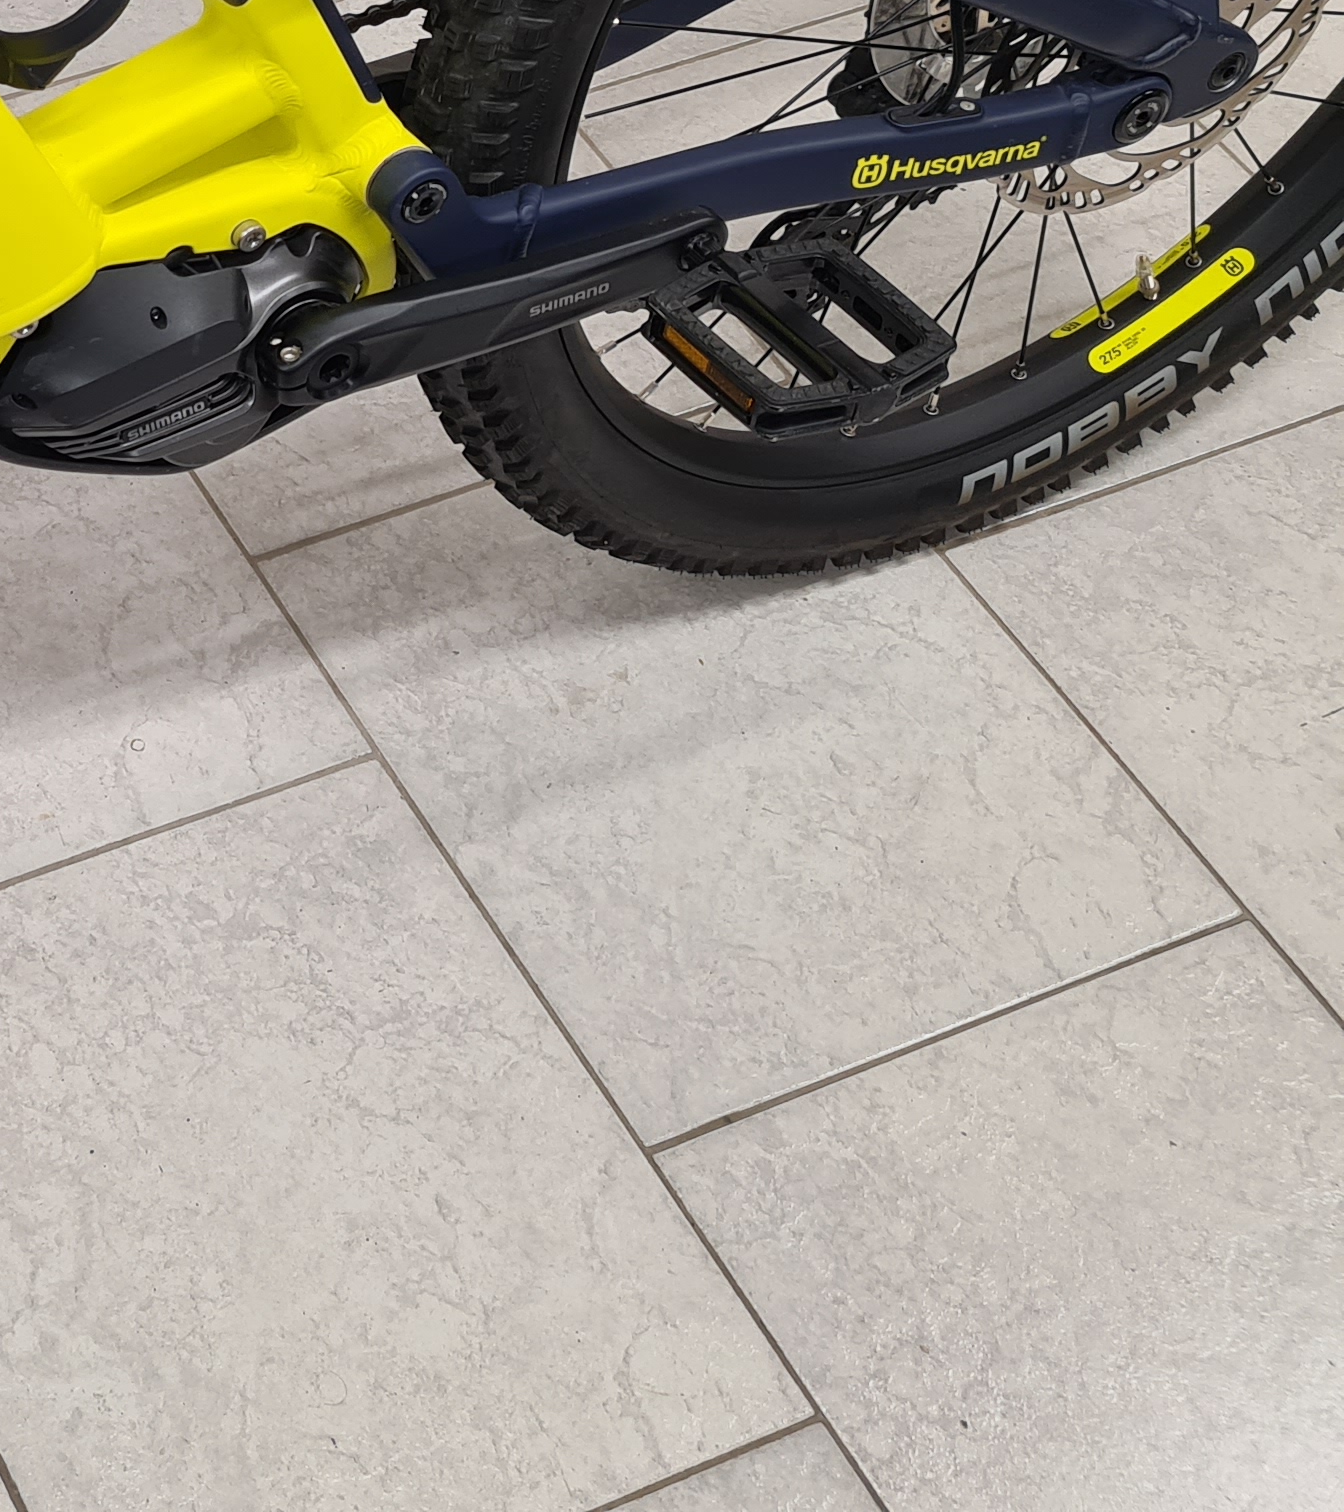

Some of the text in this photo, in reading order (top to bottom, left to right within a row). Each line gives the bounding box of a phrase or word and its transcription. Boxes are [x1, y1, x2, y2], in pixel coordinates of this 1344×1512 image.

[528, 281, 611, 320] SHIMANO
[125, 399, 207, 443] SHIMANO
[958, 326, 1223, 506] NOBBY
